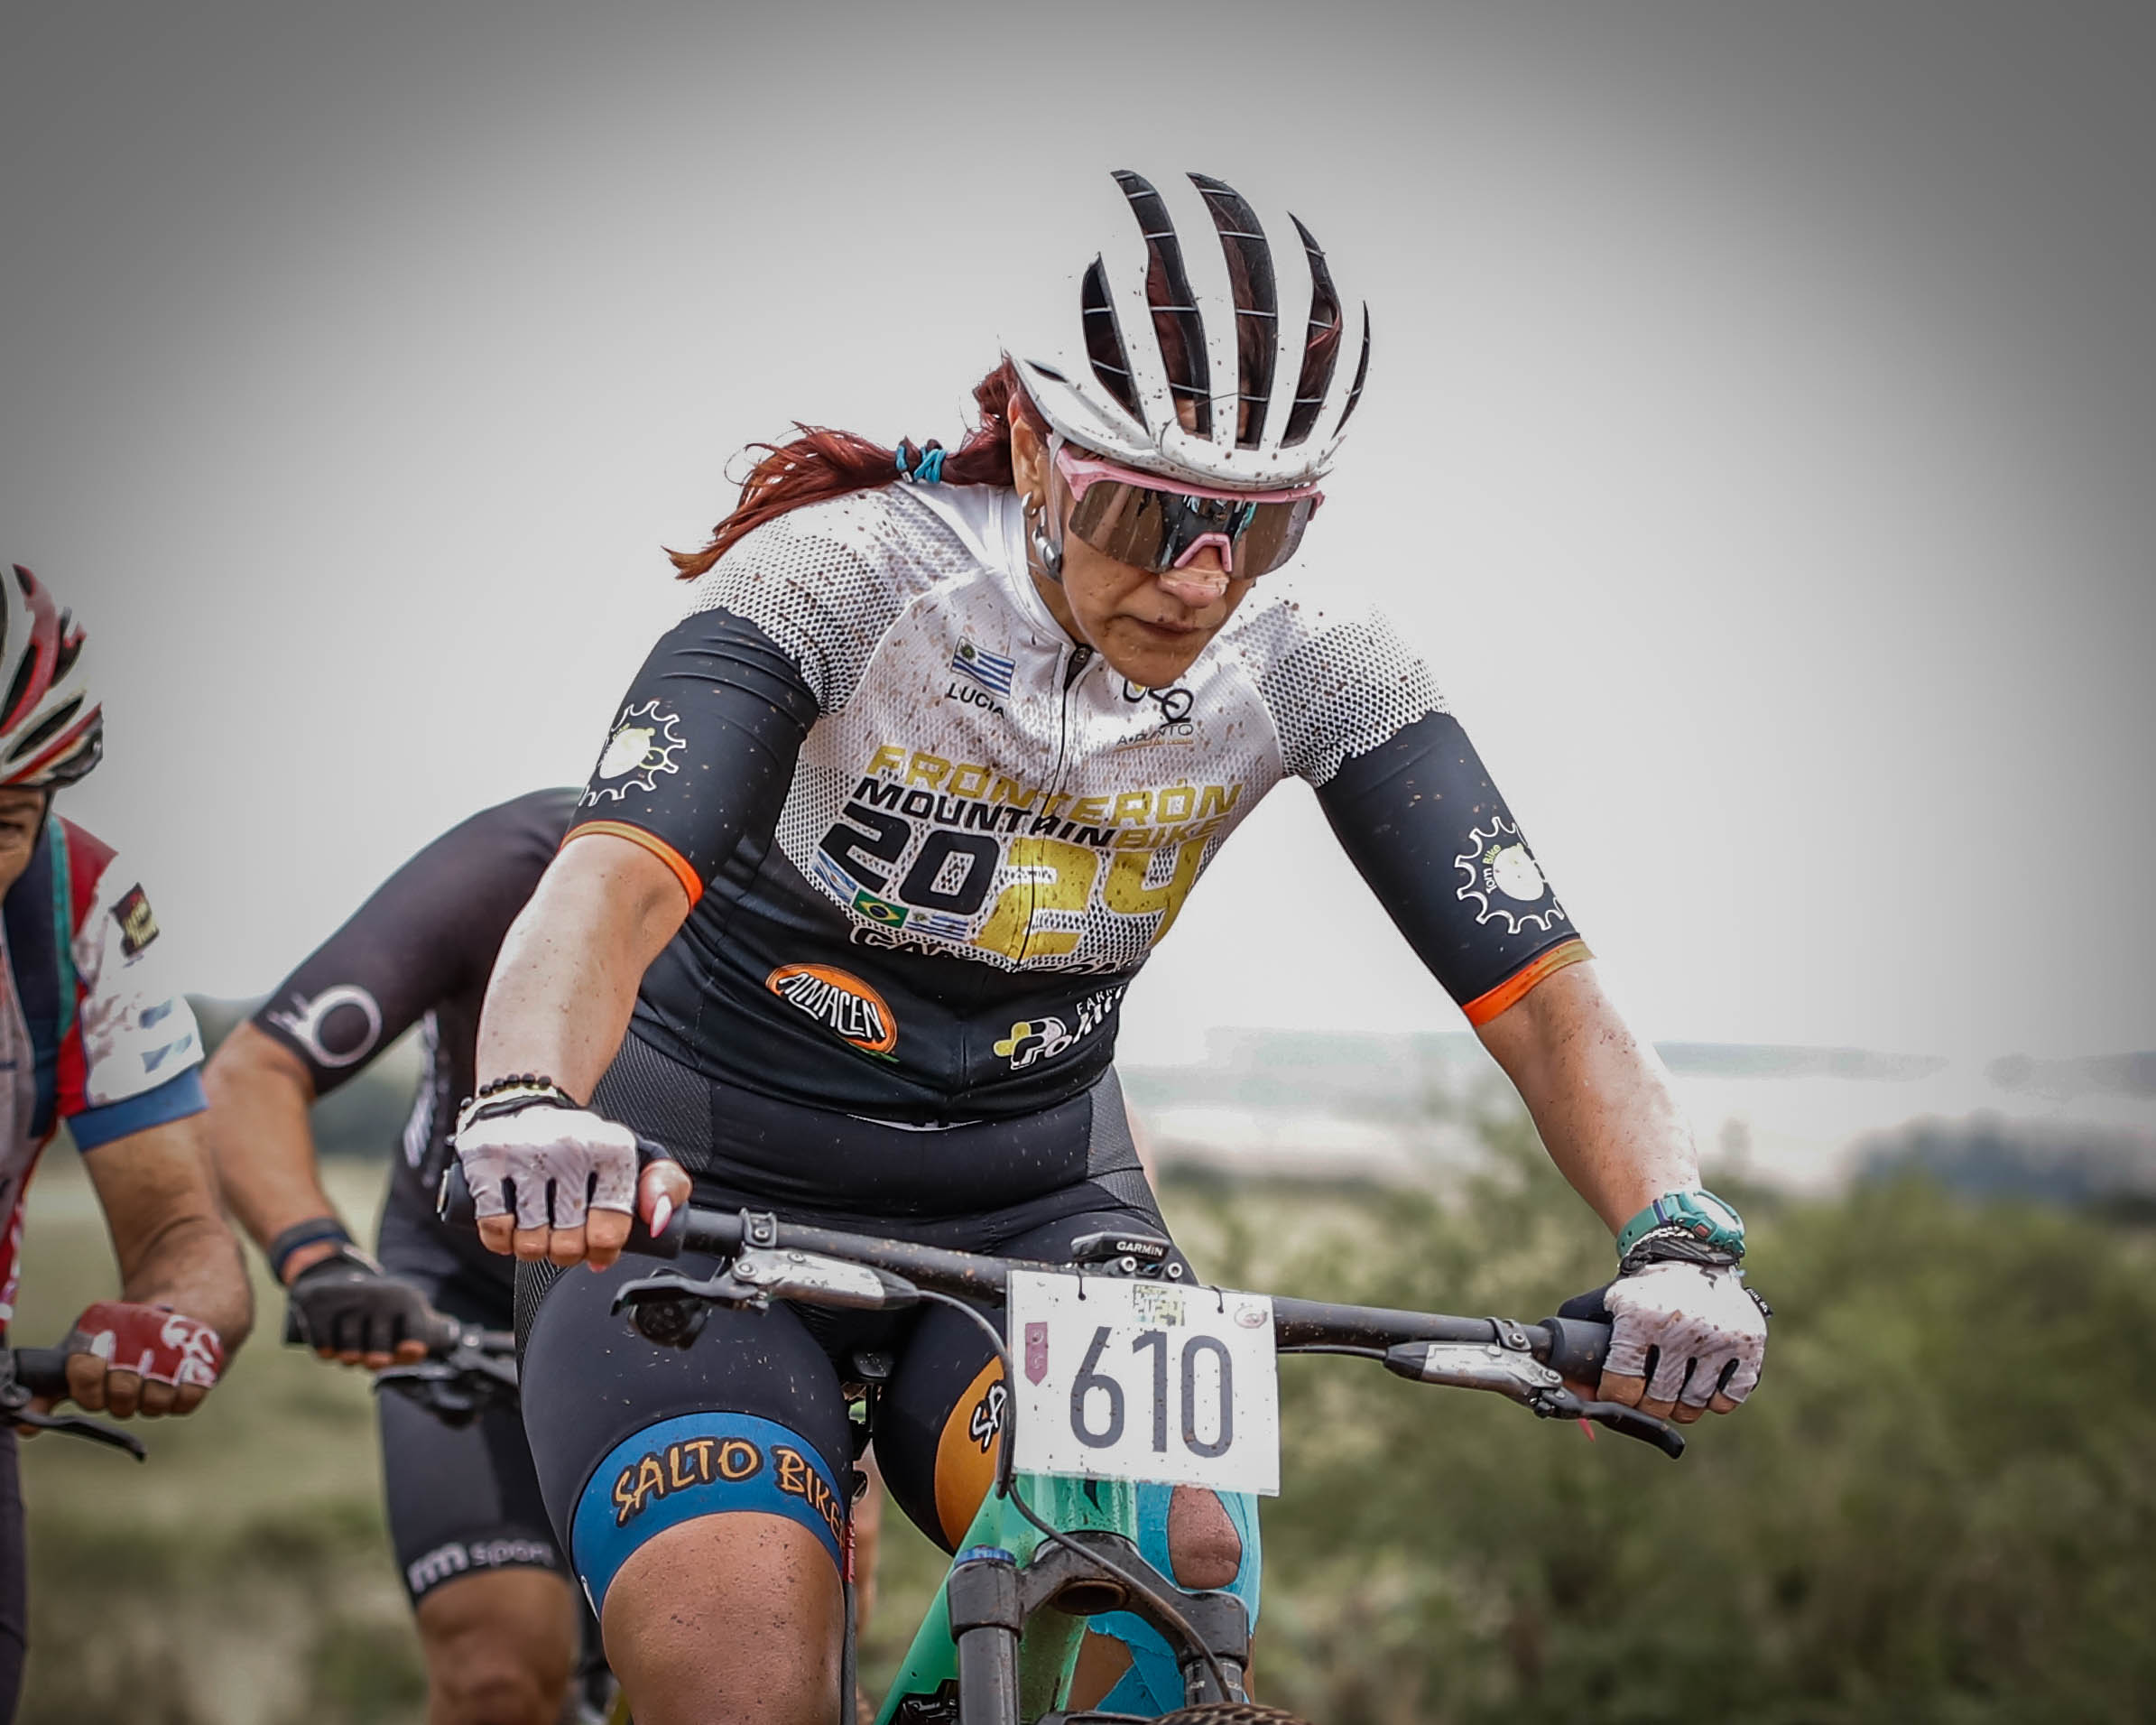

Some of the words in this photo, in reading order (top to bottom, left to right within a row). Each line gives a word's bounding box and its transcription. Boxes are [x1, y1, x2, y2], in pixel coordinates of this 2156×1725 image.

[945, 682, 1005, 719] LUCIA
[778, 972, 887, 1039] ALMACEN
[1116, 1241, 1163, 1257] GARMIN
[1069, 1326, 1234, 1458] 610
[615, 1439, 760, 1525] SALTO
